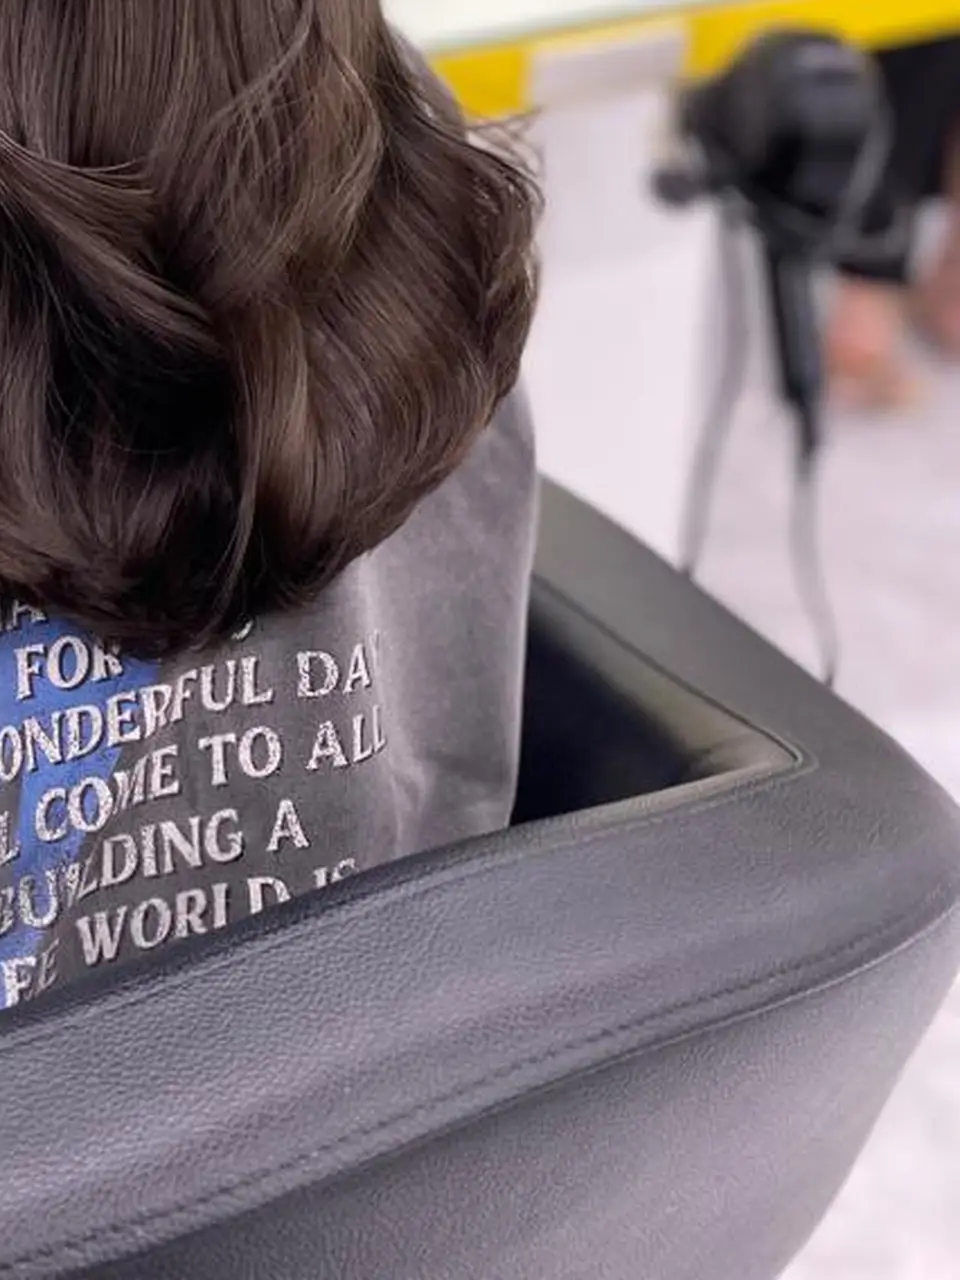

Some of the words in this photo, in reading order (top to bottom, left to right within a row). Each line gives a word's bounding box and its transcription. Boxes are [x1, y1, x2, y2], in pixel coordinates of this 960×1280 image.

[35, 744, 179, 842] COME
[198, 725, 283, 786] TO
[305, 704, 386, 770] ALL
[266, 799, 310, 851] A
